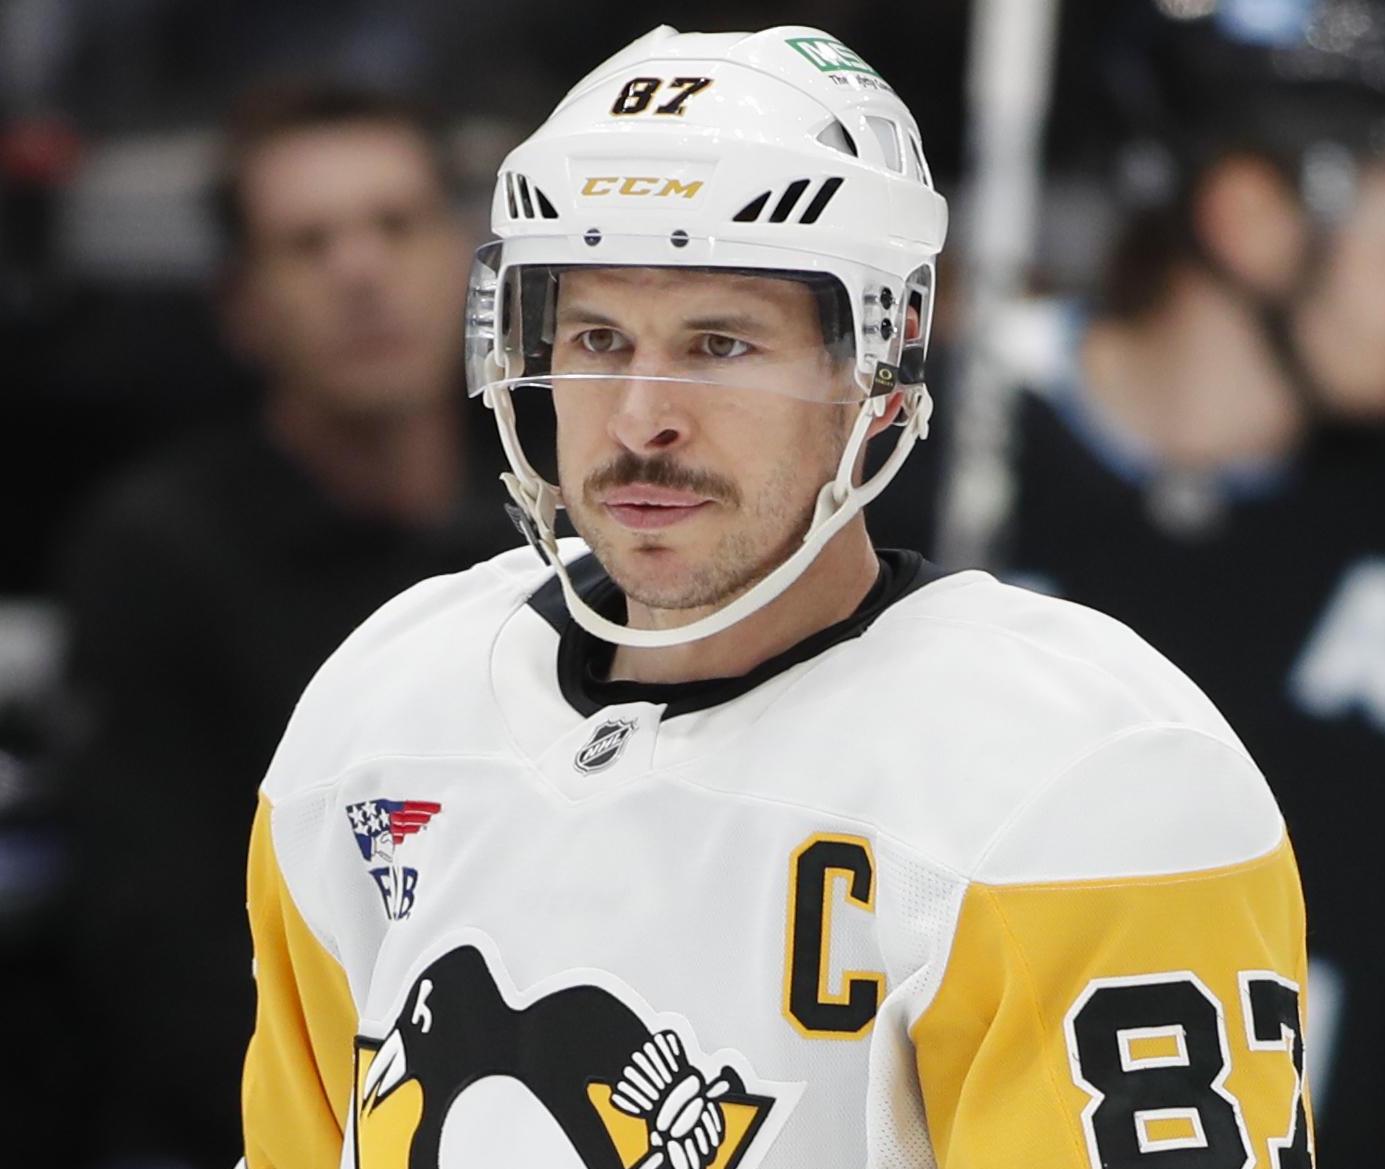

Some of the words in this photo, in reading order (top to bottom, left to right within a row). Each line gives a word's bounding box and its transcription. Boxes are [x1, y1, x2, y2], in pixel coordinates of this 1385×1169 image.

[609, 77, 713, 117] 87
[581, 176, 704, 199] CCM
[581, 730, 622, 762] NHL
[781, 832, 886, 1039] C
